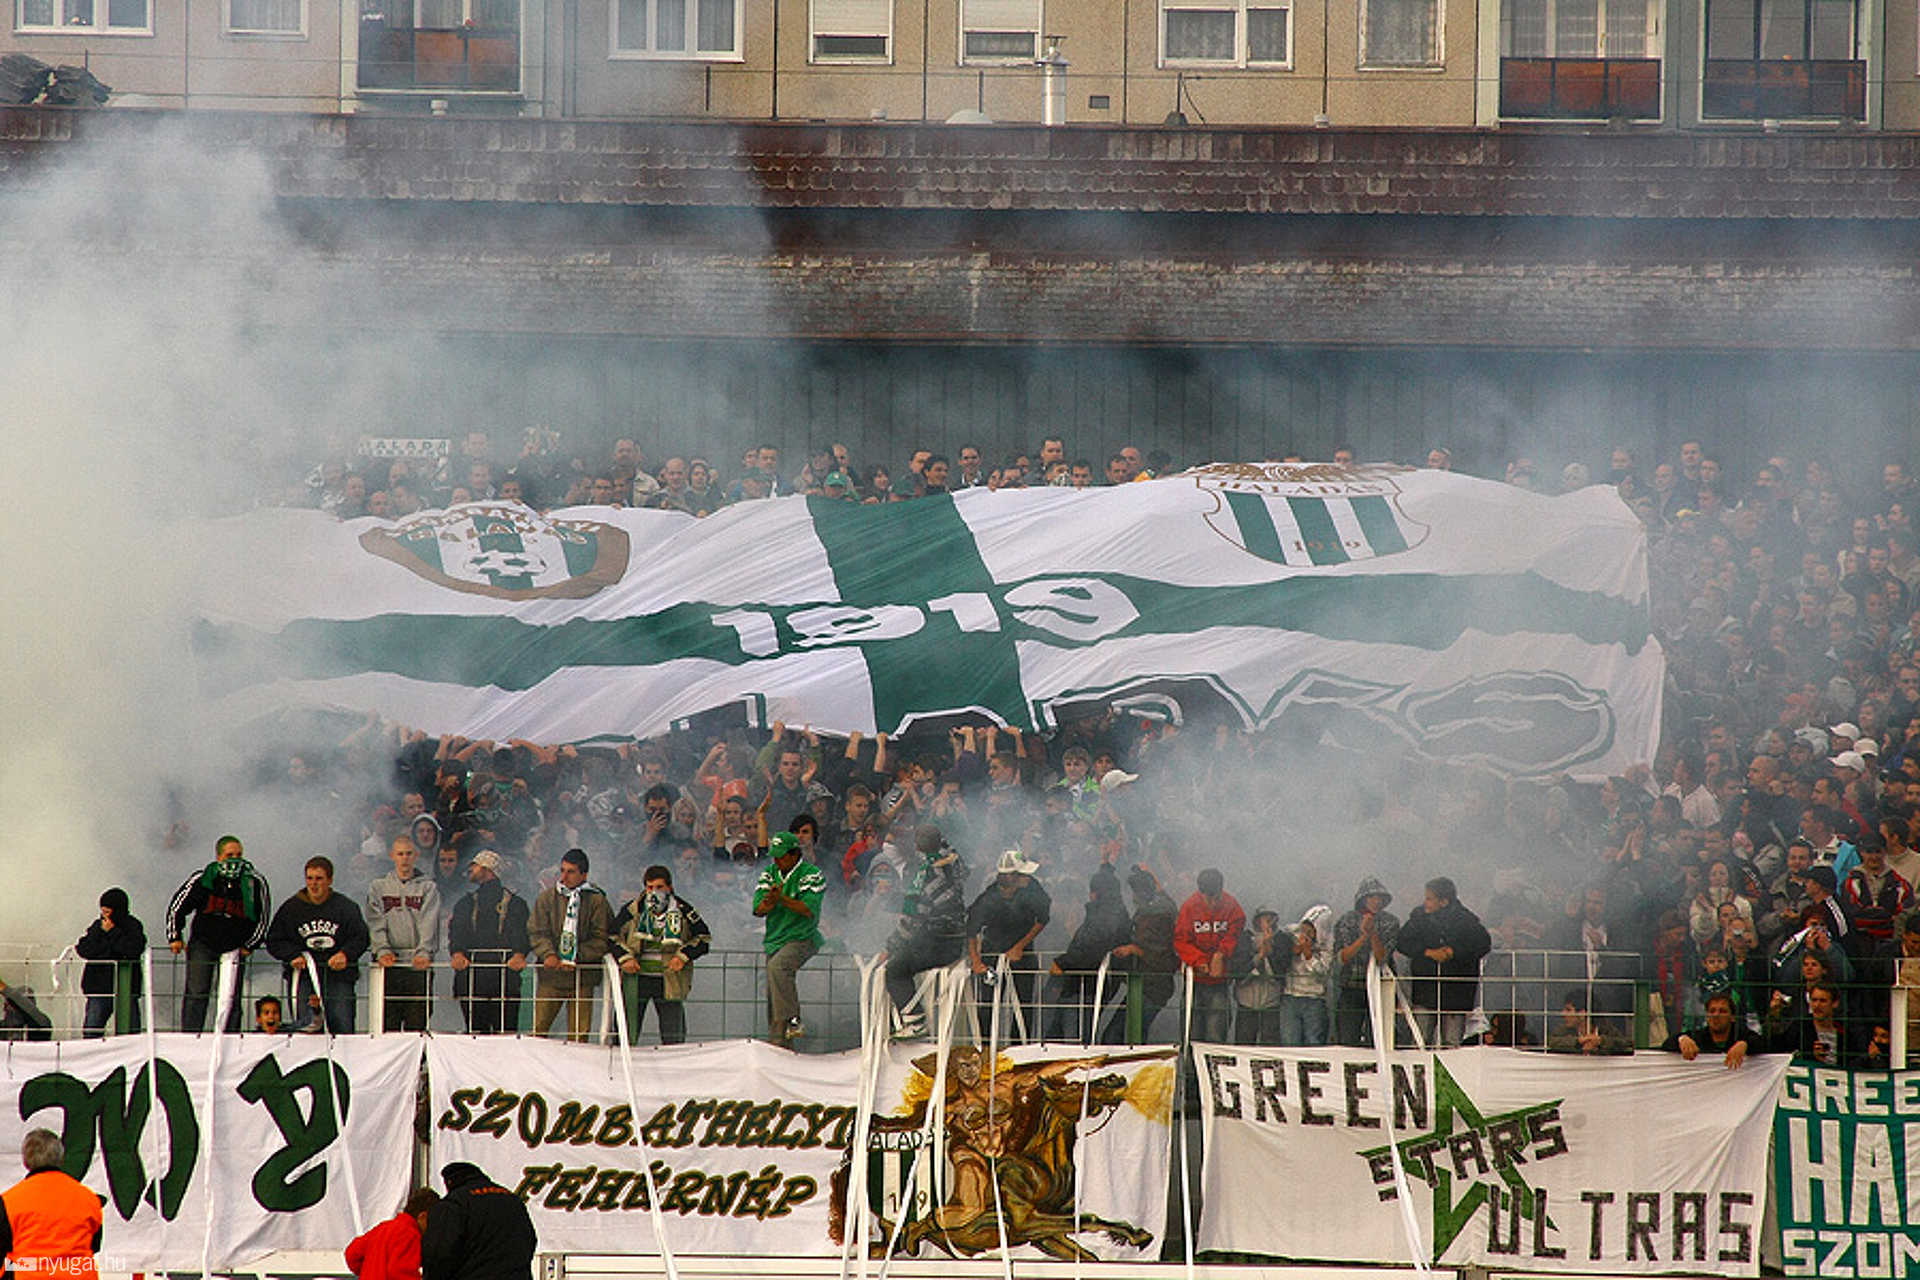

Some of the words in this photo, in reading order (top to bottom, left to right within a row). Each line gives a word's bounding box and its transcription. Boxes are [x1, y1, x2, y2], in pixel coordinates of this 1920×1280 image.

[711, 578, 1141, 657] 1919
[1204, 1053, 1429, 1130] GREEN
[513, 1160, 818, 1221] FEHÉRNÉP
[1366, 1107, 1569, 1202] STARS
[1487, 1183, 1754, 1263] ULTRAS
